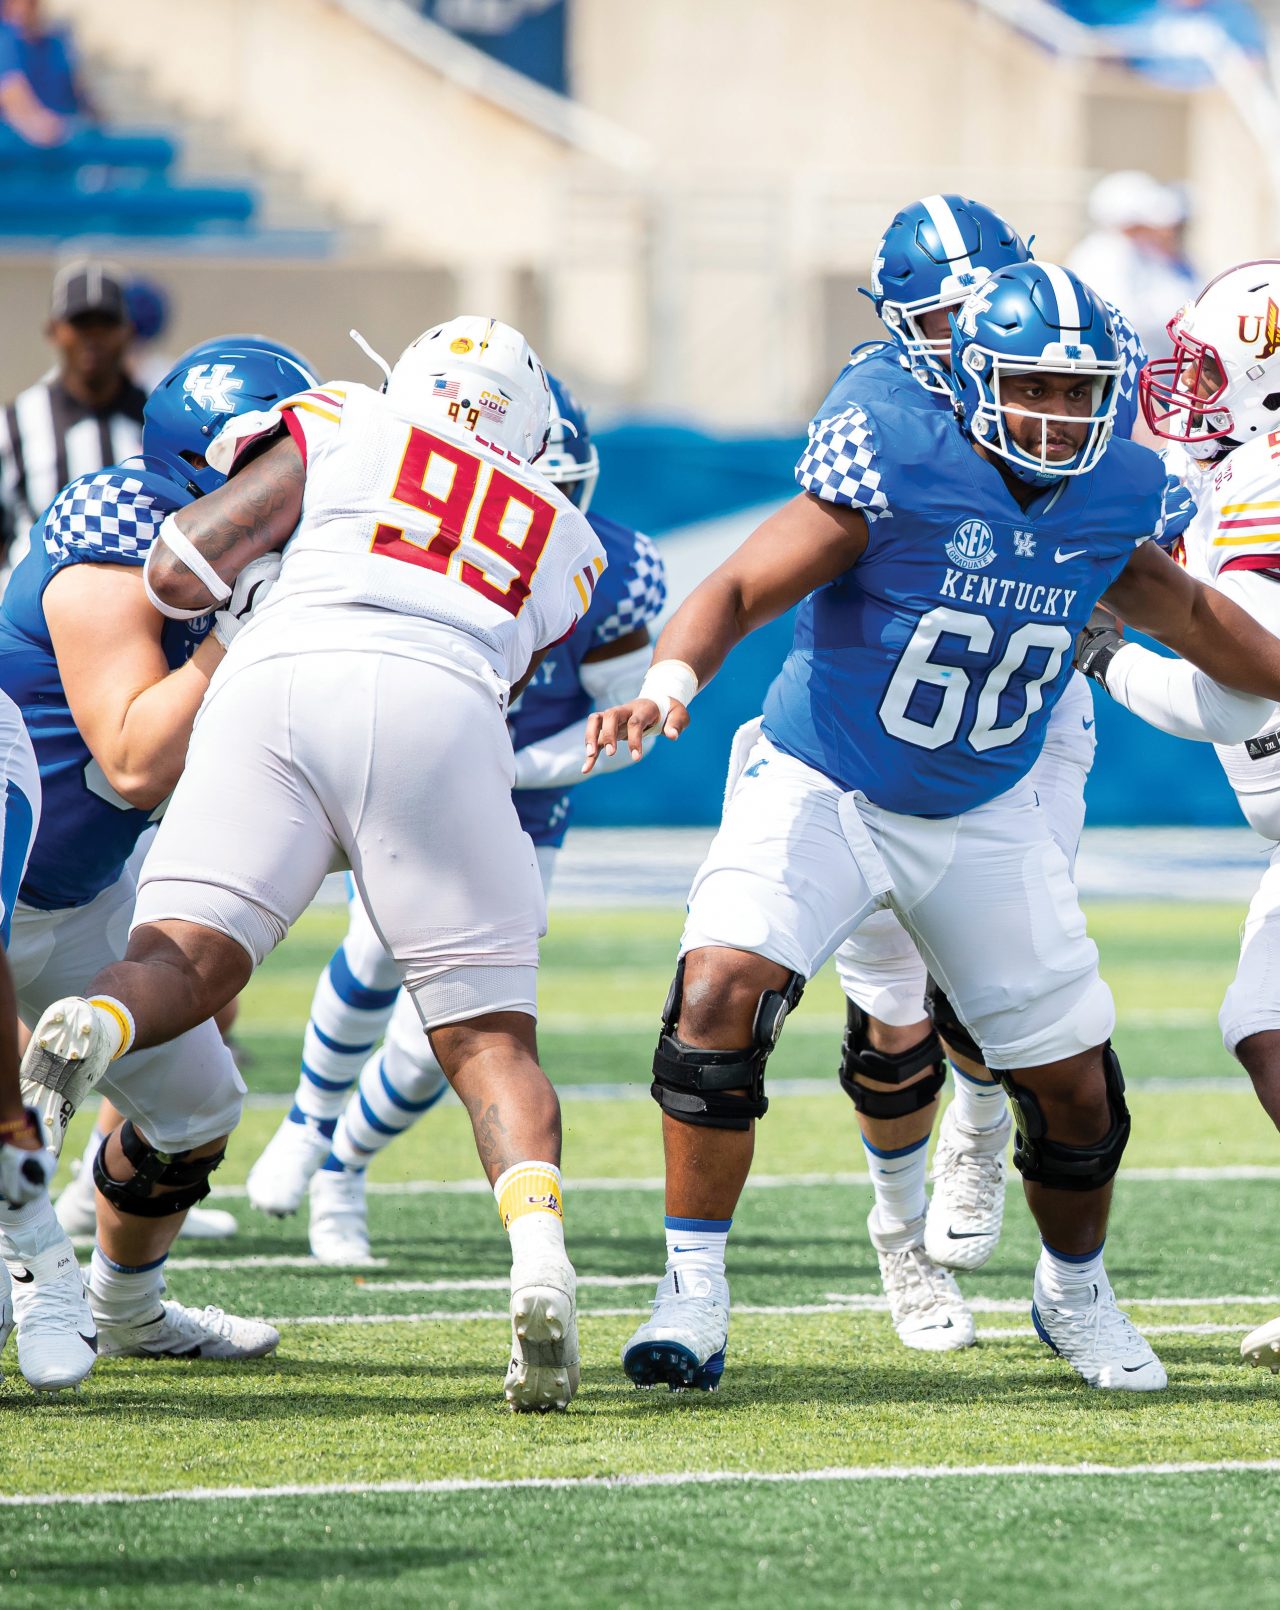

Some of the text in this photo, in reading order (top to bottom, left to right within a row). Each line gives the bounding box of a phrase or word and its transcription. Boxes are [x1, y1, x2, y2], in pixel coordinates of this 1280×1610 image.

[182, 363, 244, 414] UK
[447, 401, 480, 431] 99
[368, 421, 558, 620] 99
[956, 522, 990, 557] SEC
[949, 550, 990, 570] GRADUATE
[1012, 529, 1038, 558] UK
[939, 567, 1078, 618] KENTUCKY
[877, 604, 1073, 754] 60
